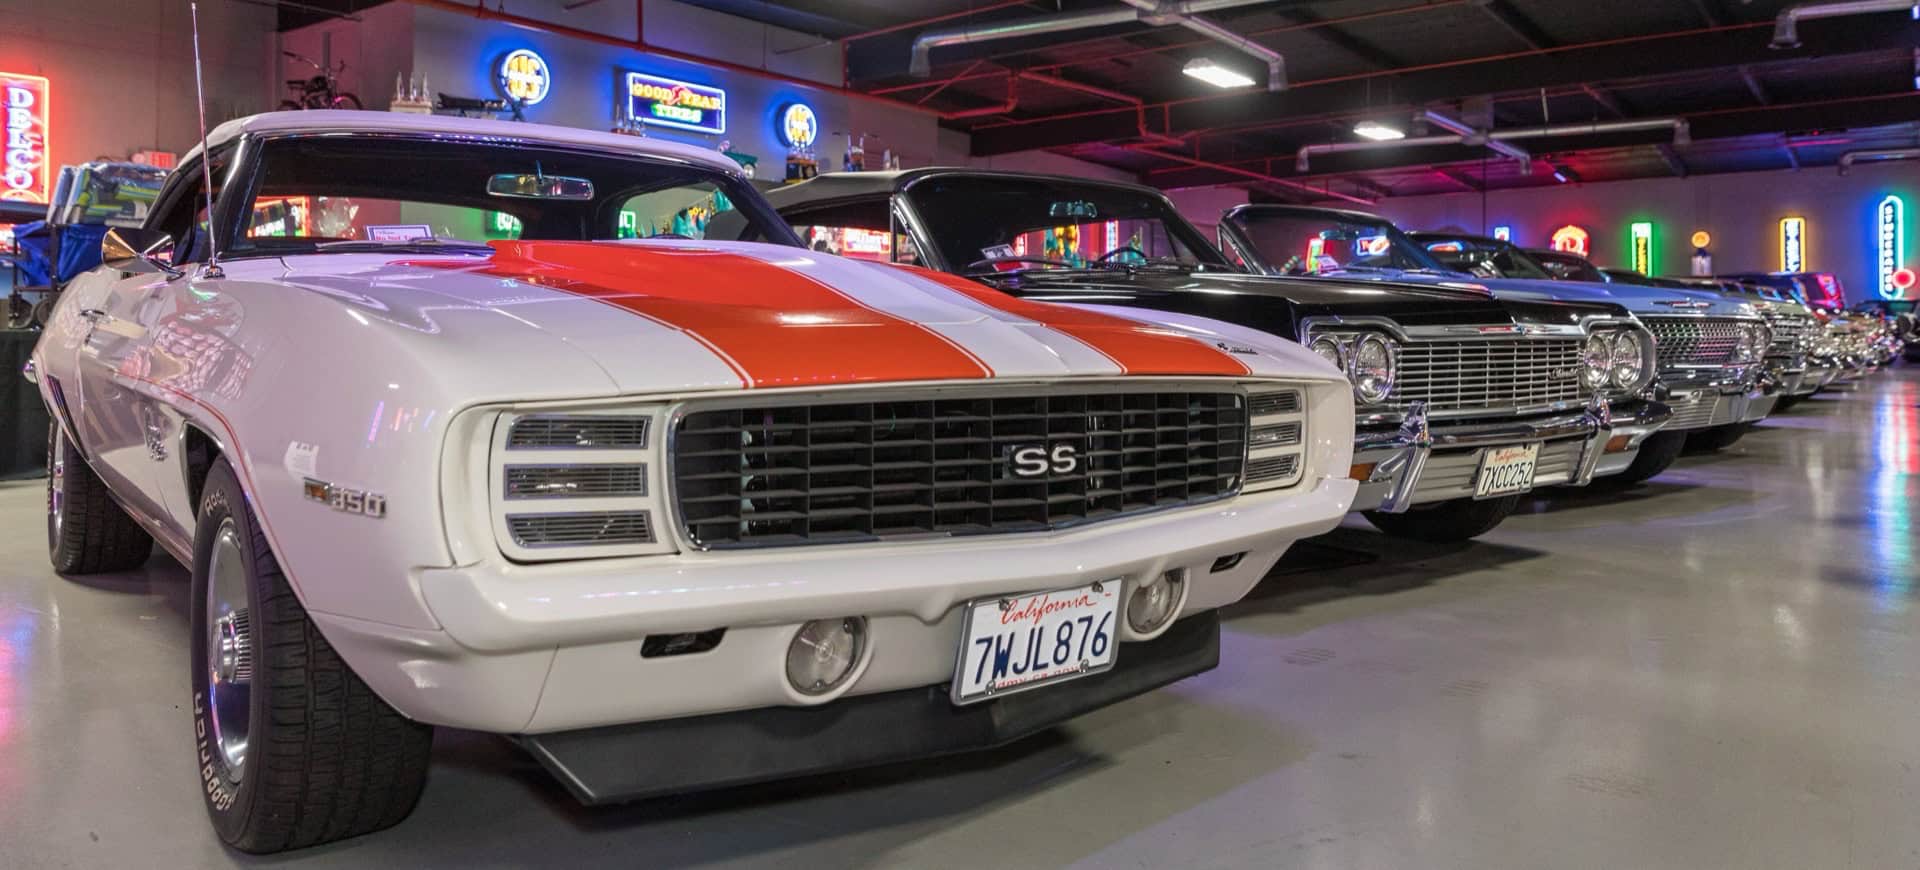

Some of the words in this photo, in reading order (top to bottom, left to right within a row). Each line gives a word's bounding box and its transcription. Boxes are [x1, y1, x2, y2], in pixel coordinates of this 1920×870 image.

[632, 83, 673, 101] GOOD
[680, 91, 721, 110] YEAR
[1016, 446, 1076, 475] SS
[1482, 461, 1533, 492] 7XCC252
[331, 487, 385, 518] 350
[1001, 594, 1096, 625] California
[975, 610, 1112, 685] 7WJL876
